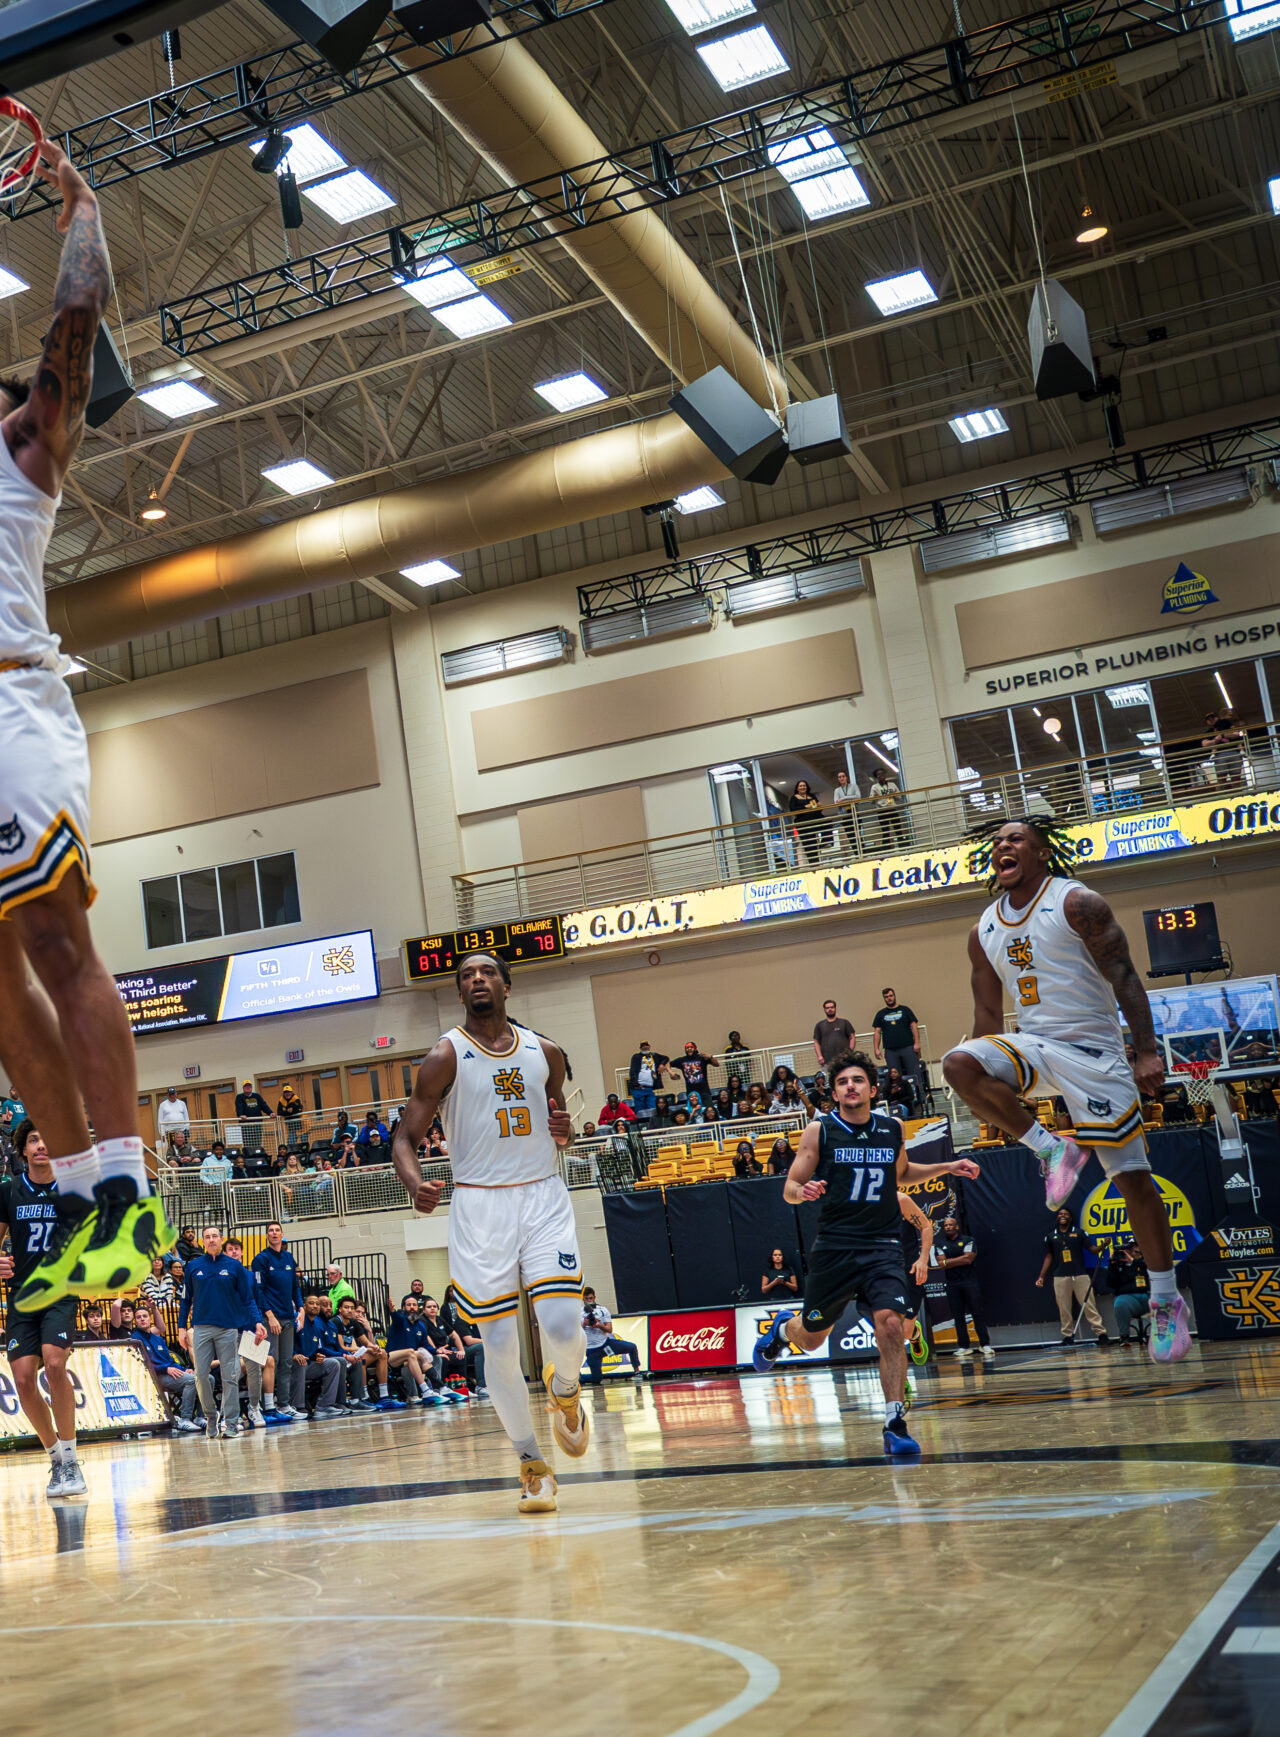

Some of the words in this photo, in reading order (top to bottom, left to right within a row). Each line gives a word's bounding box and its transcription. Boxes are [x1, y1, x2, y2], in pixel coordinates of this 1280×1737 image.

[1165, 578, 1206, 597] Superior
[1169, 591, 1208, 609] PLUMBING
[985, 662, 1090, 696] SUPERIOR
[1095, 637, 1209, 674] PLUMBING
[1111, 813, 1173, 838] Superior
[1117, 833, 1175, 857] PLUMBING
[823, 874, 861, 900] No
[872, 860, 958, 892] Leaky
[749, 877, 803, 902] Superior
[754, 895, 804, 917] PLUMBING
[589, 900, 694, 938] G.O.A.T.
[1157, 910, 1197, 930] 13.3
[421, 938, 442, 951] KSU
[464, 929, 495, 949] 13.3
[511, 919, 553, 936] DELAWARE
[418, 953, 441, 971] 87
[534, 934, 555, 951] 78
[146, 977, 154, 985] a
[240, 981, 268, 993] FIFTH
[271, 976, 300, 989] THIRD
[130, 985, 157, 999] Third
[241, 995, 276, 1010] Official
[278, 991, 302, 1004] Bank
[304, 990, 316, 1001] of
[317, 987, 331, 998] the
[333, 982, 361, 997] Owls
[1017, 976, 1040, 1006] 9
[140, 994, 182, 1009] soaring
[143, 1005, 188, 1018] heights.
[376, 1036, 388, 1047] EXIT
[288, 1050, 300, 1060] EXIT
[186, 1067, 196, 1076] EXIT
[495, 1107, 532, 1138] 13
[834, 1148, 863, 1163] BLUE
[866, 1148, 895, 1163] HENS
[850, 1167, 885, 1202] 12
[924, 1177, 946, 1193] Go
[1223, 1181, 1251, 1189] adidas
[16, 1204, 43, 1220] BLUE
[1230, 1239, 1274, 1247] AUTOMOTIVE
[1220, 1246, 1274, 1259] EdVoyles.com
[656, 1326, 728, 1354] Coca-Cola
[101, 1379, 129, 1395] Superior
